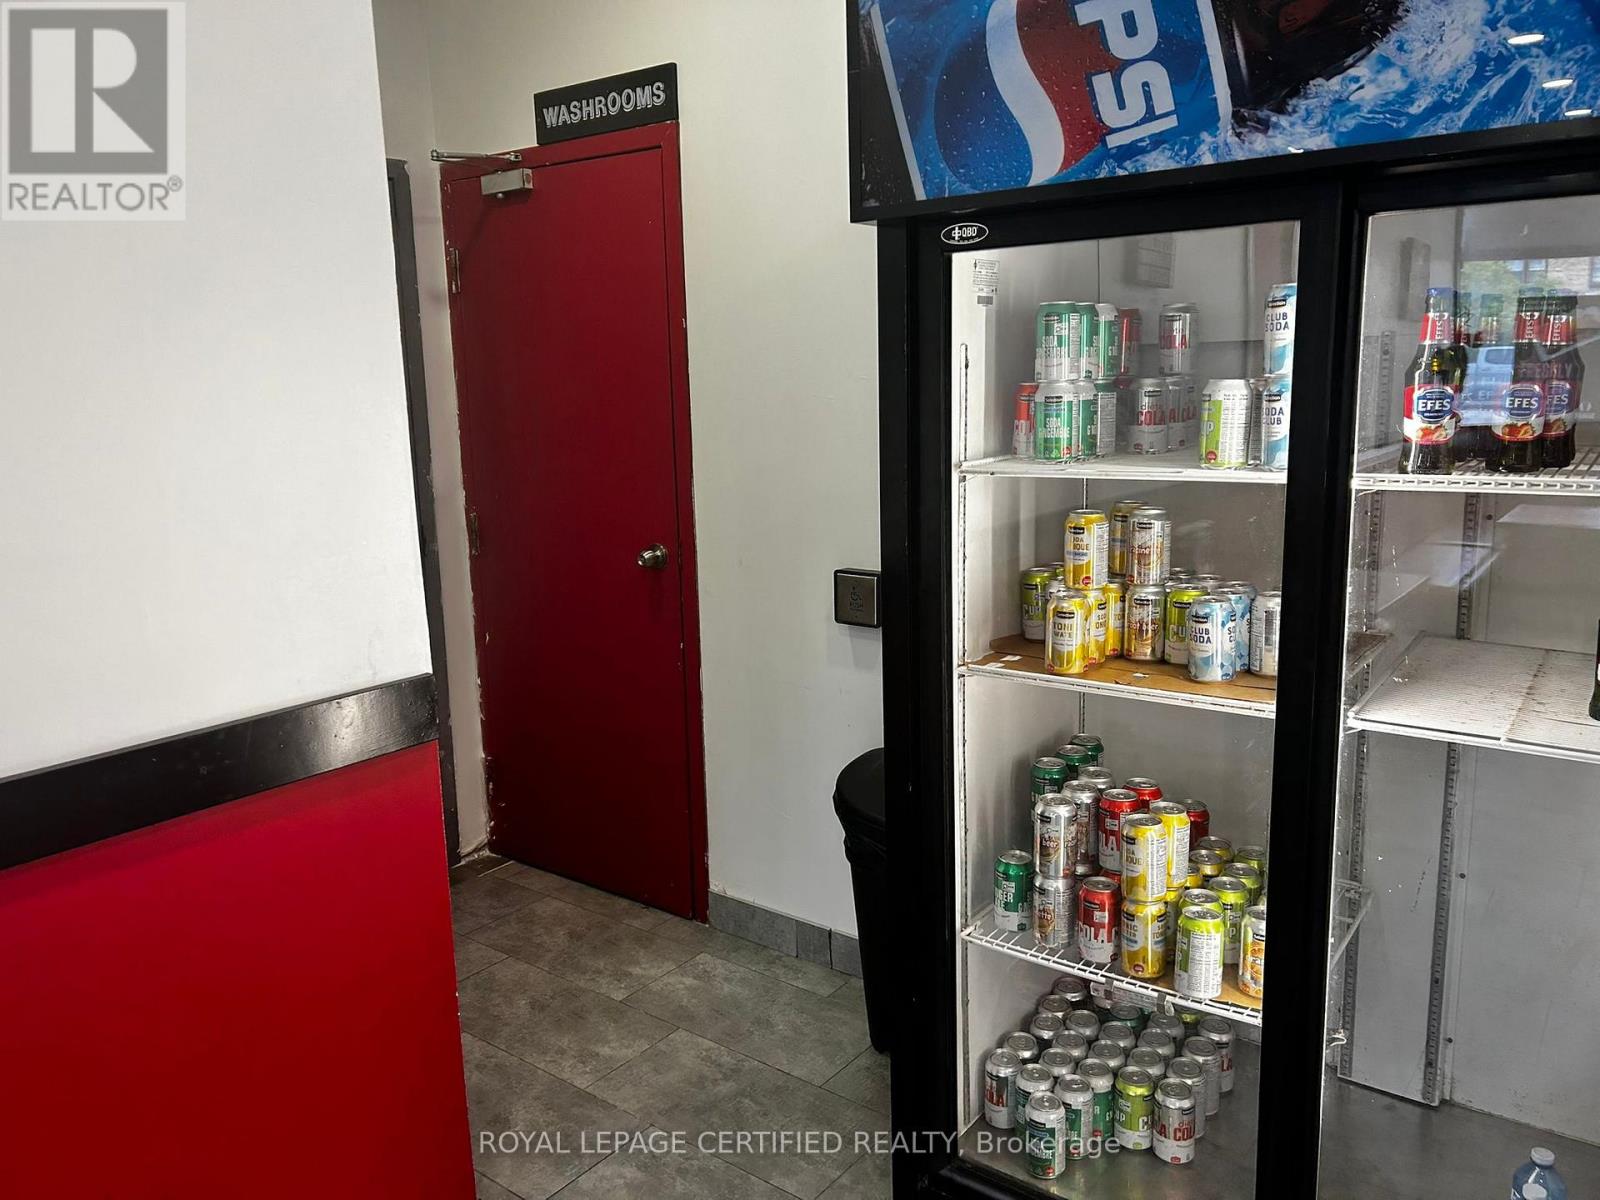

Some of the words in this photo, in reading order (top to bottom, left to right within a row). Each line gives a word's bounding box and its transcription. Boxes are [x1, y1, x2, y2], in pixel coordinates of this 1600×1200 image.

[542, 81, 666, 128] WASHROOMS
[1266, 312, 1288, 322] CLUB
[1265, 321, 1290, 332] SODA
[1418, 399, 1451, 411] EFES
[1505, 397, 1539, 409] EFES
[1136, 410, 1166, 426] COLA
